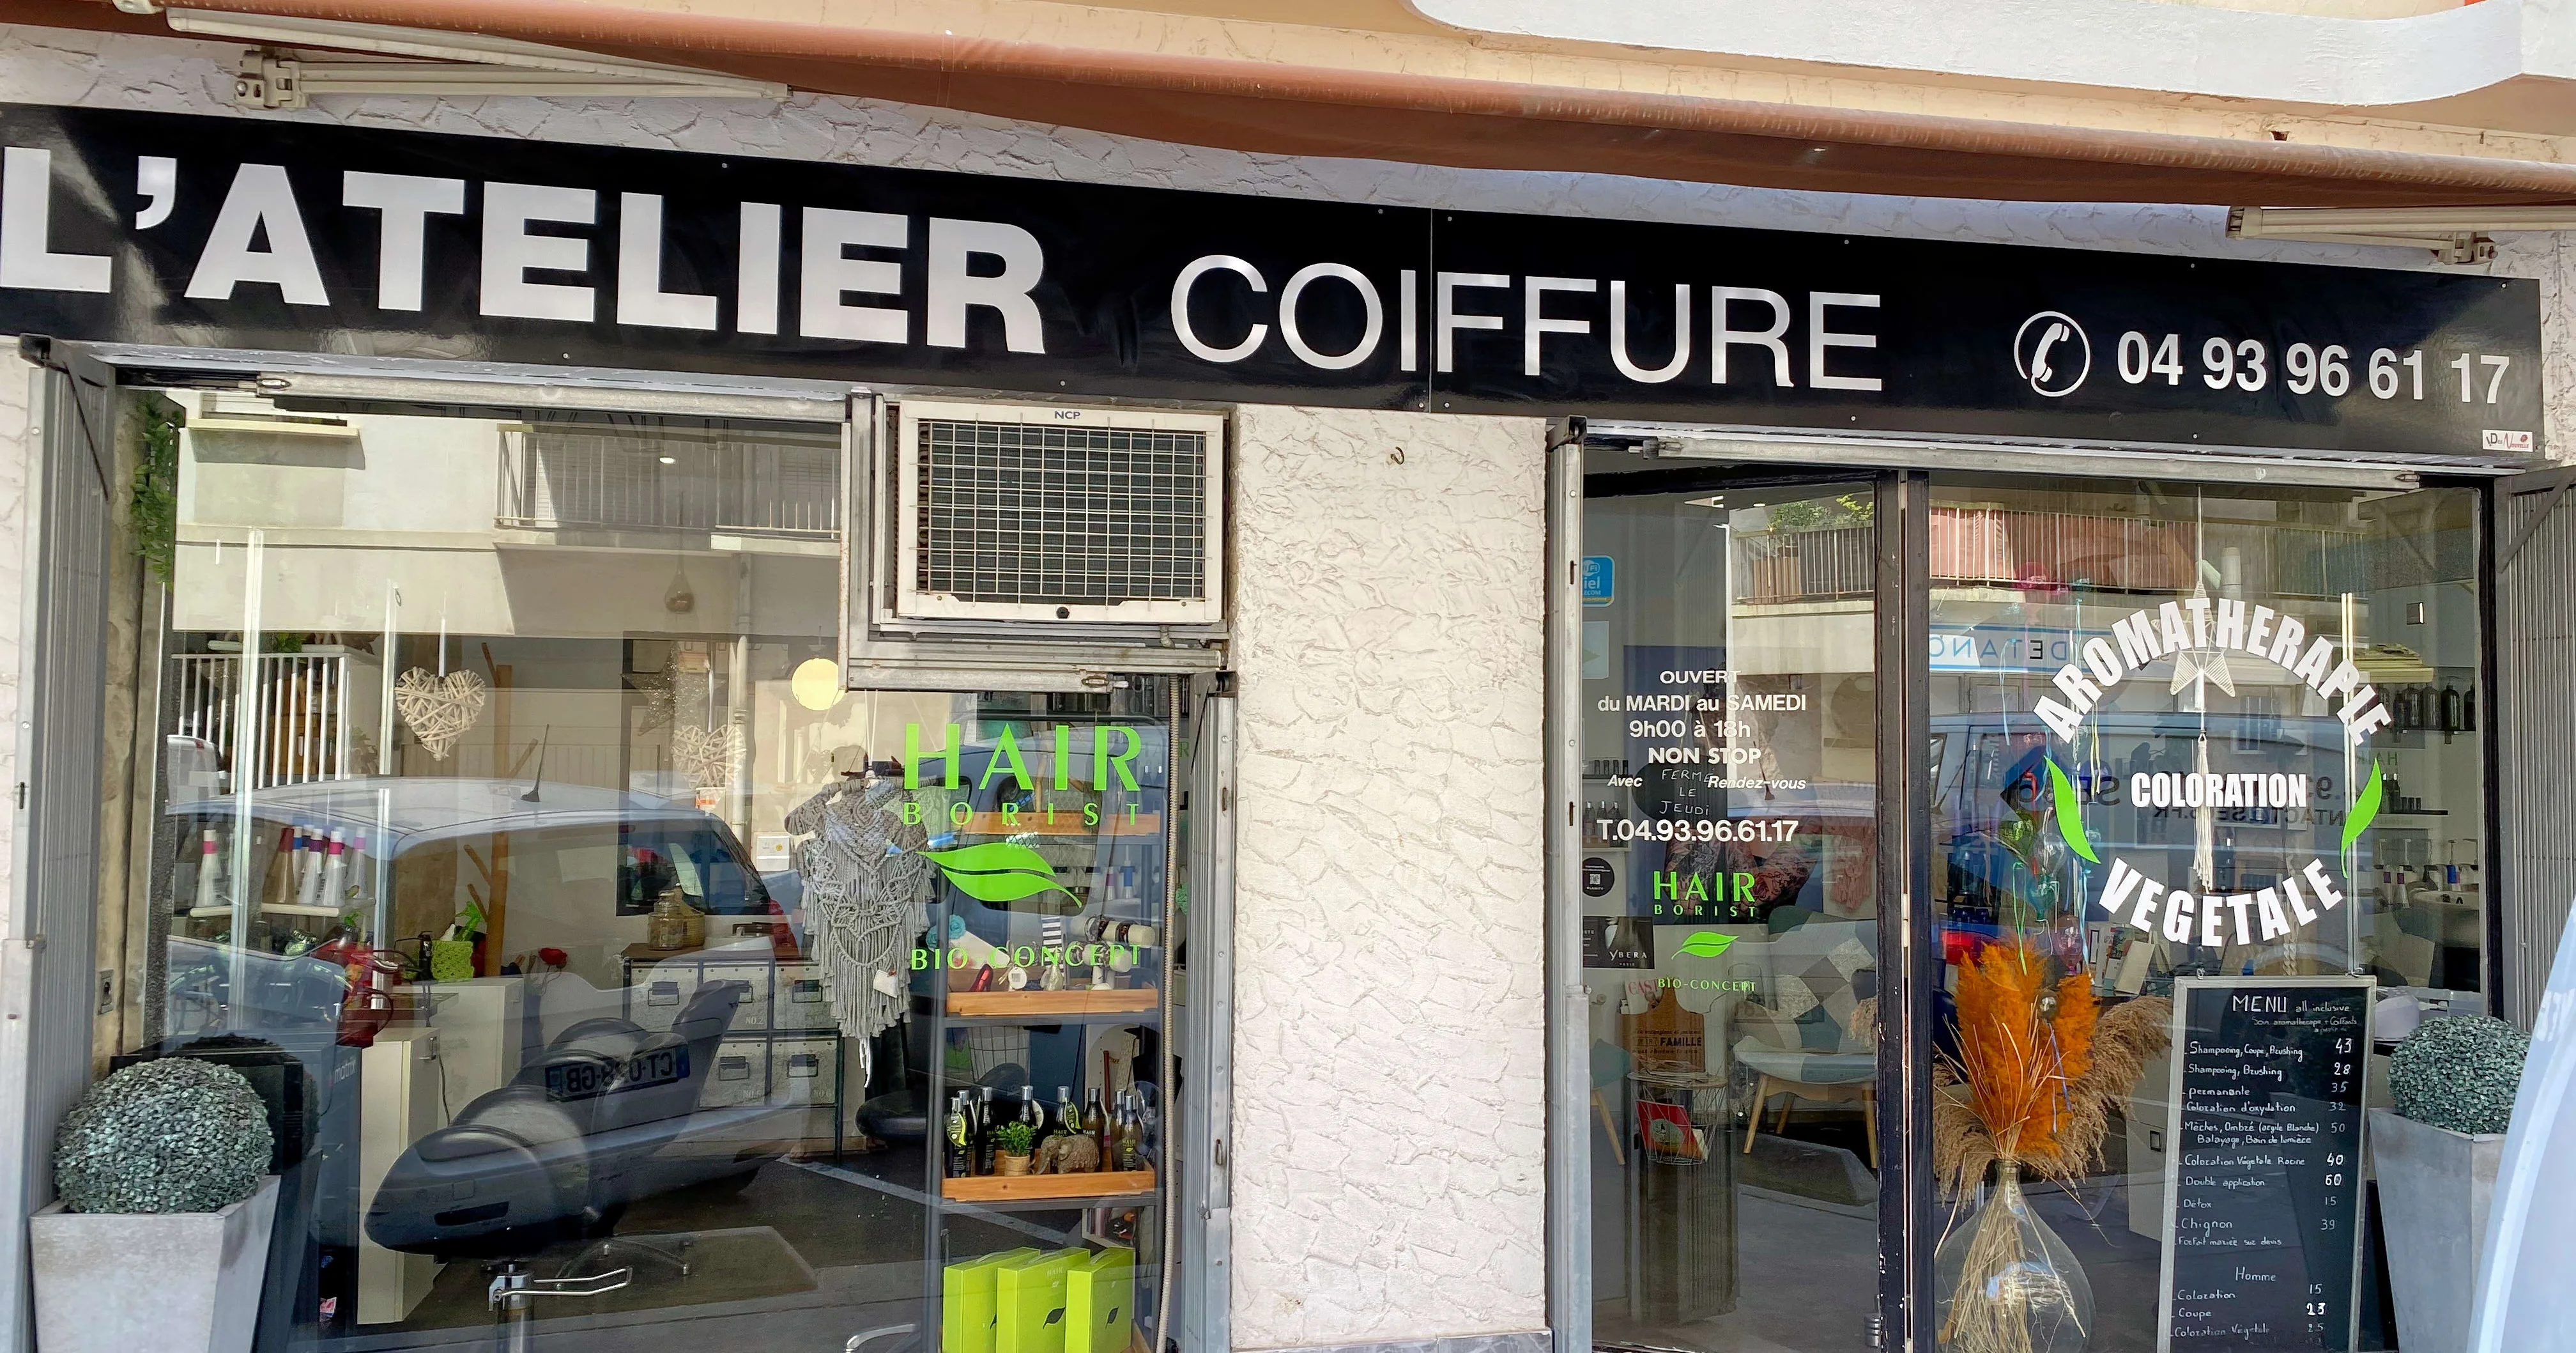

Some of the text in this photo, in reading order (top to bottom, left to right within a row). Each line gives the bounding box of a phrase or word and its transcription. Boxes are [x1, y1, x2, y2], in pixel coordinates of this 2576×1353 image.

[0, 146, 1883, 392] L'ATELIER COIFFURE
[2117, 330, 2511, 405] 04 93 96 61 17
[1054, 410, 1081, 420] NCP
[1659, 670, 1742, 683] OUVERT
[2033, 598, 2391, 746] AROMATHERAPIE
[1597, 694, 1807, 711] du MARDI au SAMEDI
[1629, 720, 1751, 738] 9h00 à 18h
[904, 723, 1142, 792] HAIR
[1648, 747, 1761, 764] NON STOP
[1607, 775, 1807, 790] Avec Rendez-vous
[2130, 772, 2307, 808] COLORATION
[1679, 787, 1697, 798] LE
[903, 802, 1139, 826] BORIST
[1597, 819, 1799, 842] T.04.93.96.61.17
[1652, 870, 1756, 902] HAIR
[1654, 904, 1756, 916] BORIST
[2098, 857, 2343, 947] VEGETALE
[910, 944, 1142, 970] BIO-CONCEPT
[1609, 949, 1648, 961] YBERA
[1657, 978, 1756, 991] BIO-CONCEPT
[2232, 994, 2351, 1013] MENU all inclusive
[1659, 1037, 1701, 1047] FAMILLE
[2269, 1045, 2303, 1062] Brushing
[2335, 1038, 2352, 1055] 43
[2243, 1064, 2283, 1081] Brushing
[2334, 1062, 2351, 1075] 28
[2331, 1081, 2349, 1093] 35
[2186, 1101, 2236, 1113] Coloration
[2329, 1101, 2347, 1112] 32
[2331, 1122, 2345, 1133] 50
[2246, 1134, 2266, 1145] Bain
[2268, 1134, 2278, 1144] de
[2184, 1154, 2234, 1166] Coloration
[2326, 1152, 2344, 1166] 40
[2185, 1173, 2343, 1191] Double application 60
[2324, 1196, 2337, 1206] 15
[2181, 1217, 2336, 1237] Chignon 39
[2260, 1236, 2282, 1246] devis
[2235, 1266, 2277, 1282] Homme
[2177, 1283, 2323, 1301] Coloration 15
[2178, 1302, 2326, 1321] Coupe 23
